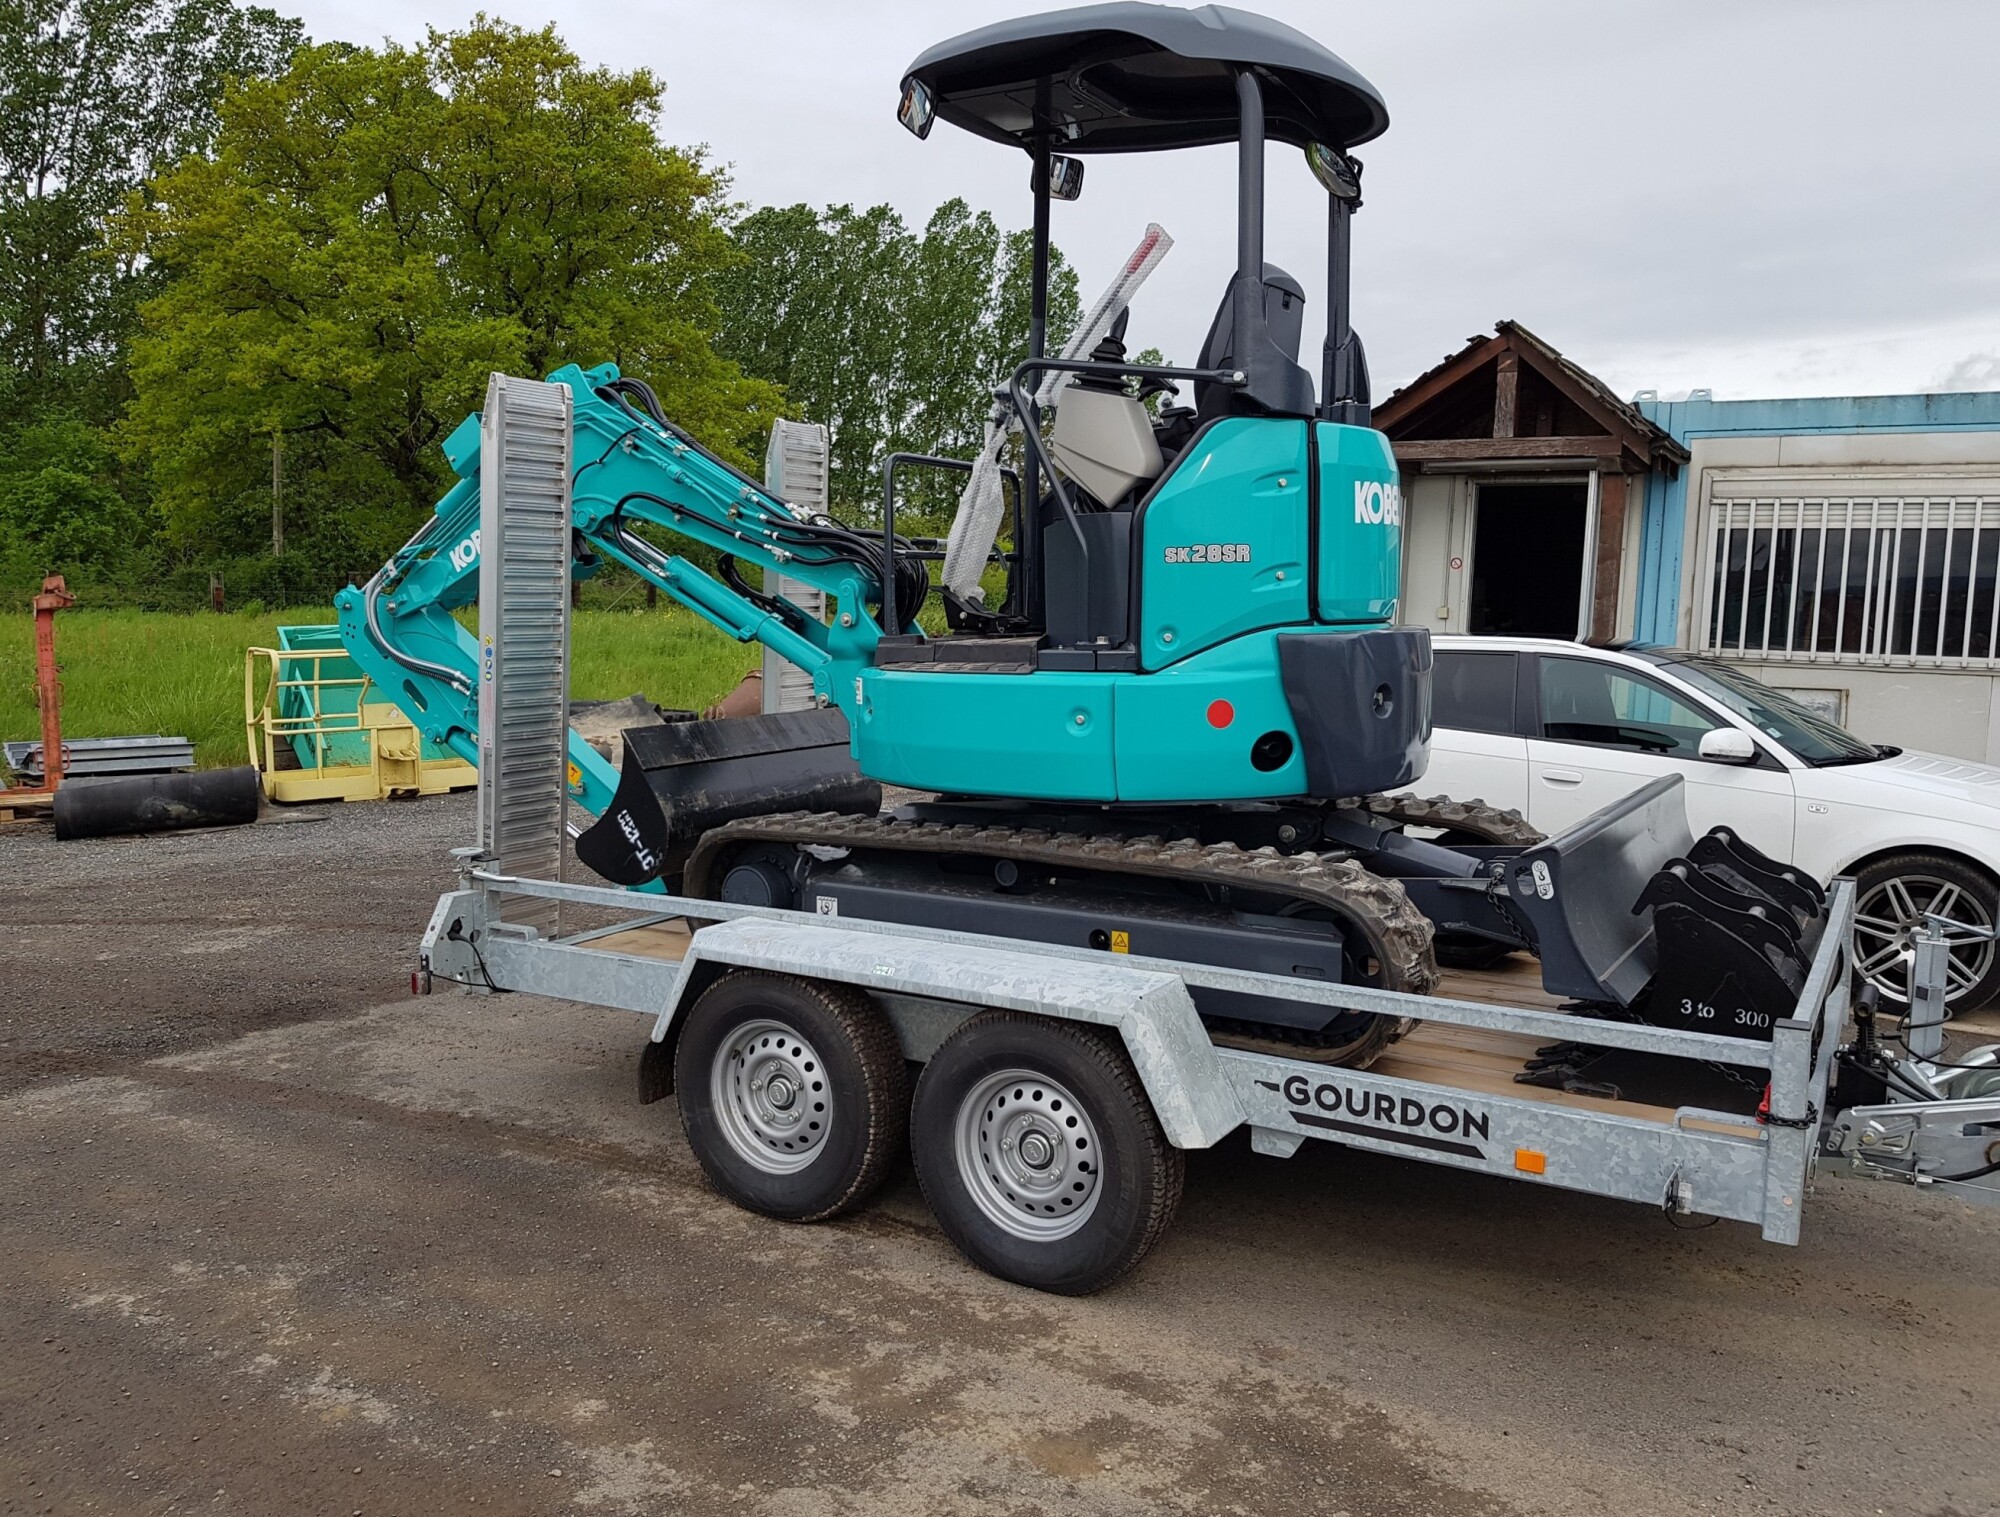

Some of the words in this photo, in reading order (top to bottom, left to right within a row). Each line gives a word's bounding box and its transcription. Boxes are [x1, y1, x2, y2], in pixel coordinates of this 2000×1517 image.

[1164, 544, 1251, 563] SK28SR
[1680, 998, 1692, 1014] 3
[1697, 1002, 1715, 1018] to
[1734, 1008, 1769, 1028] 300
[1283, 1075, 1489, 1141] GOURDON
